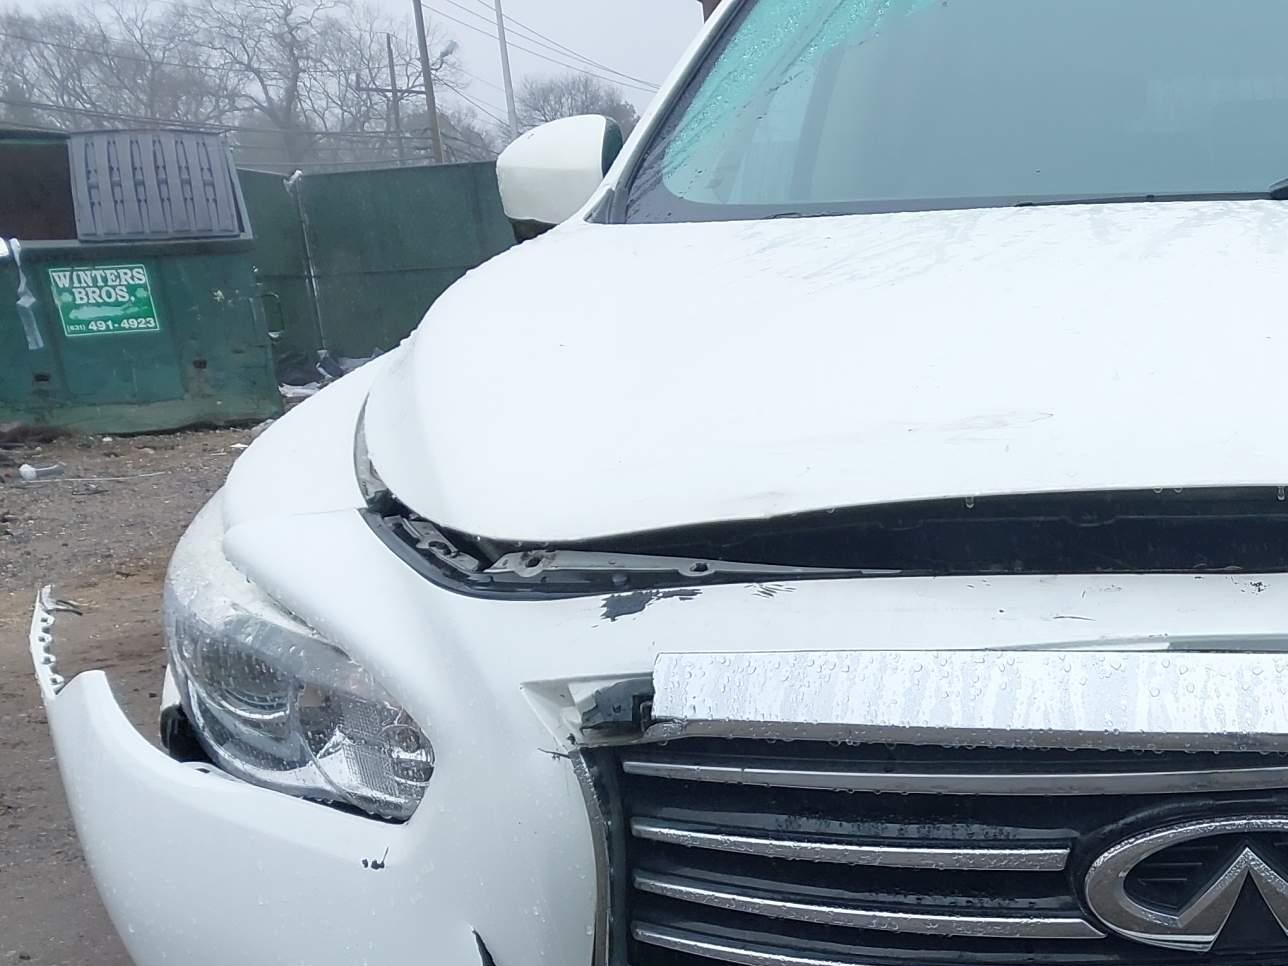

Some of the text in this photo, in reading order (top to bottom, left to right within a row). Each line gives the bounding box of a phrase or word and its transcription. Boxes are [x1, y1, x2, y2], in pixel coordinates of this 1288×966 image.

[52, 268, 146, 288] WINTERS
[72, 286, 136, 304] BROS.
[88, 317, 156, 331] 491-4923
